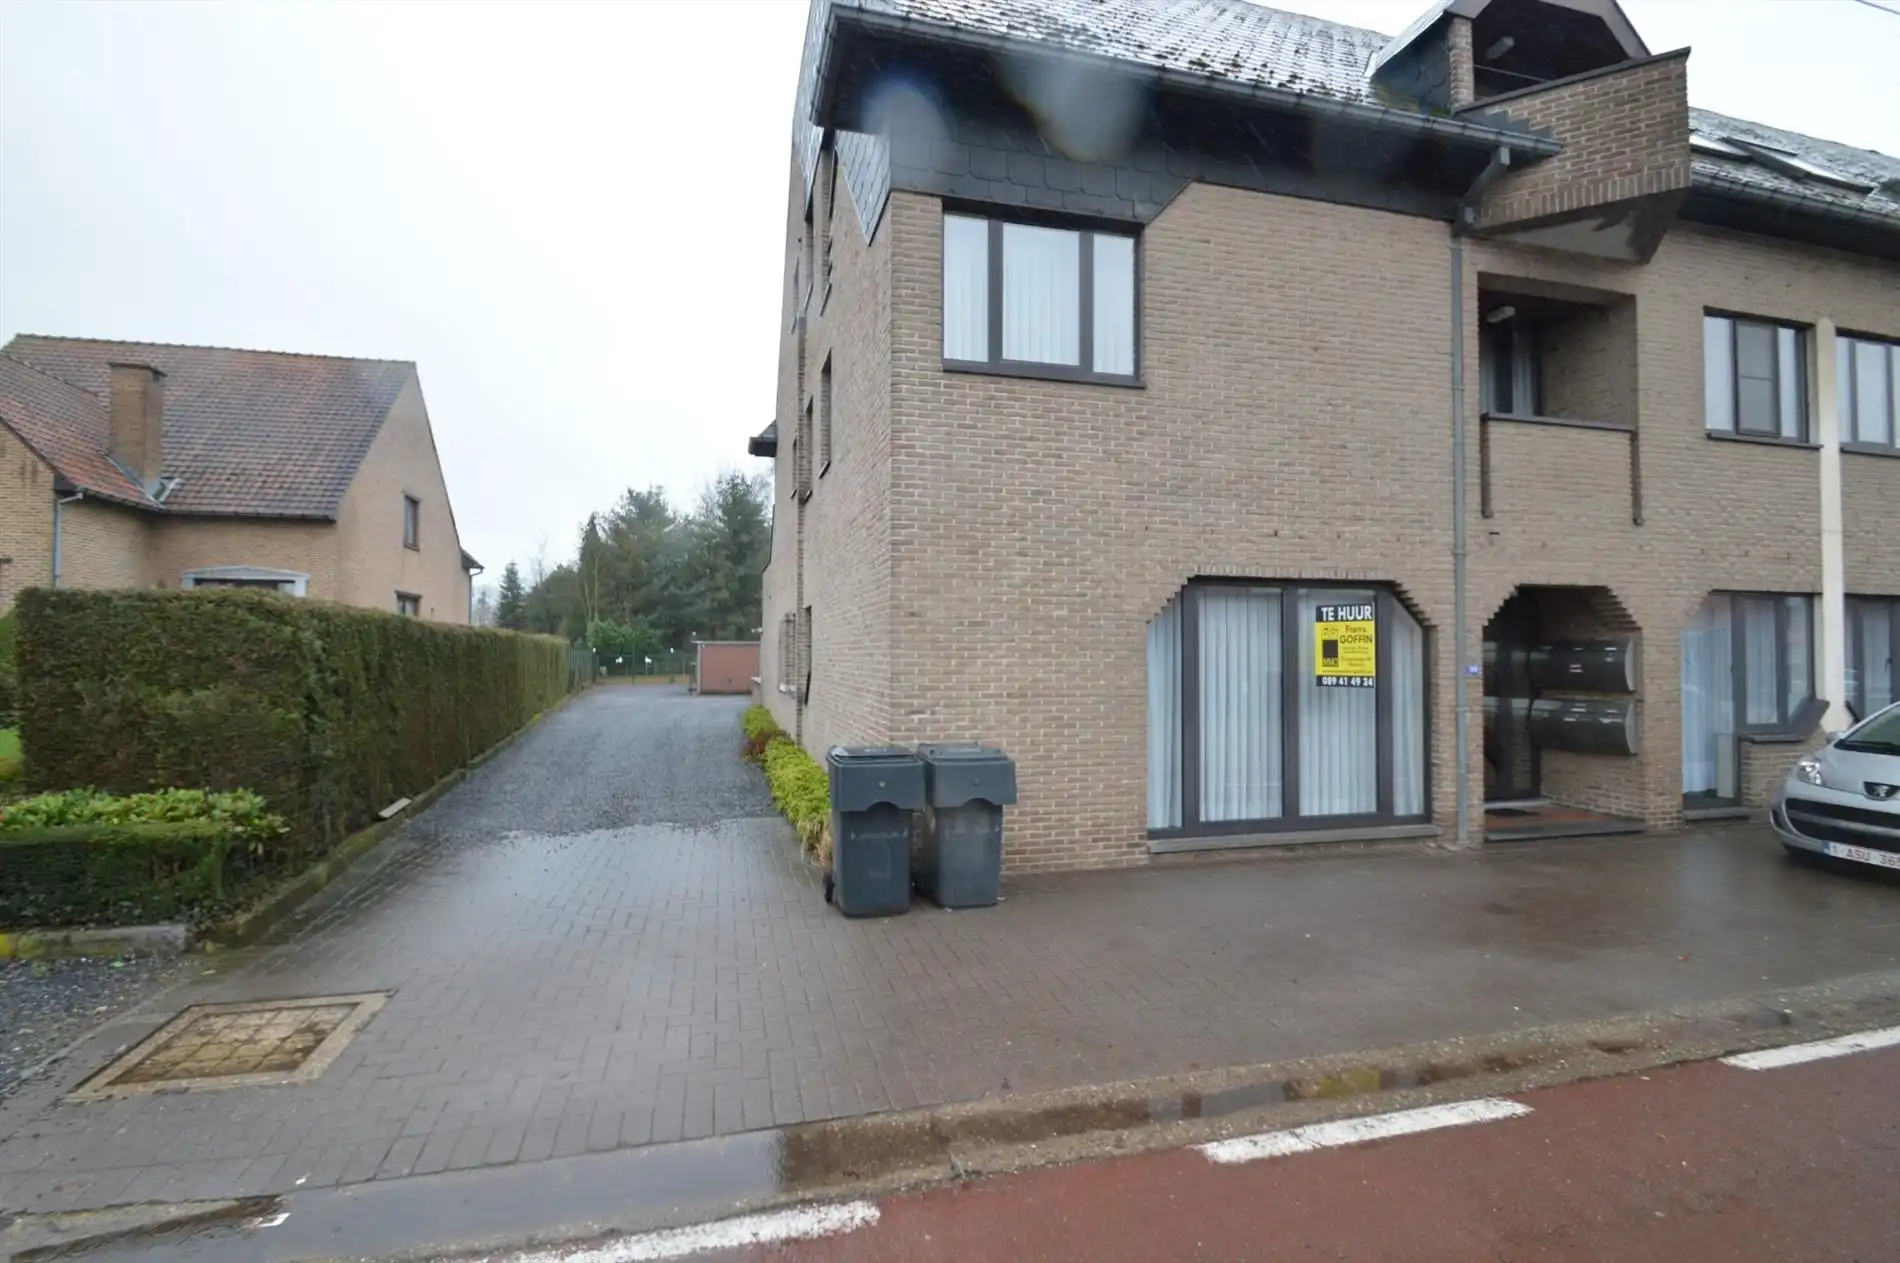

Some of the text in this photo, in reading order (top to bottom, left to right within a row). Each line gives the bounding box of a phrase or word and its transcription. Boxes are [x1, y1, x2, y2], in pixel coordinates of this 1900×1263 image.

[1321, 605, 1372, 621] TE HUUR
[1340, 634, 1372, 644] GOFFIN
[1322, 676, 1337, 686] 089
[1338, 677, 1348, 686] 41
[1362, 678, 1373, 687] 34
